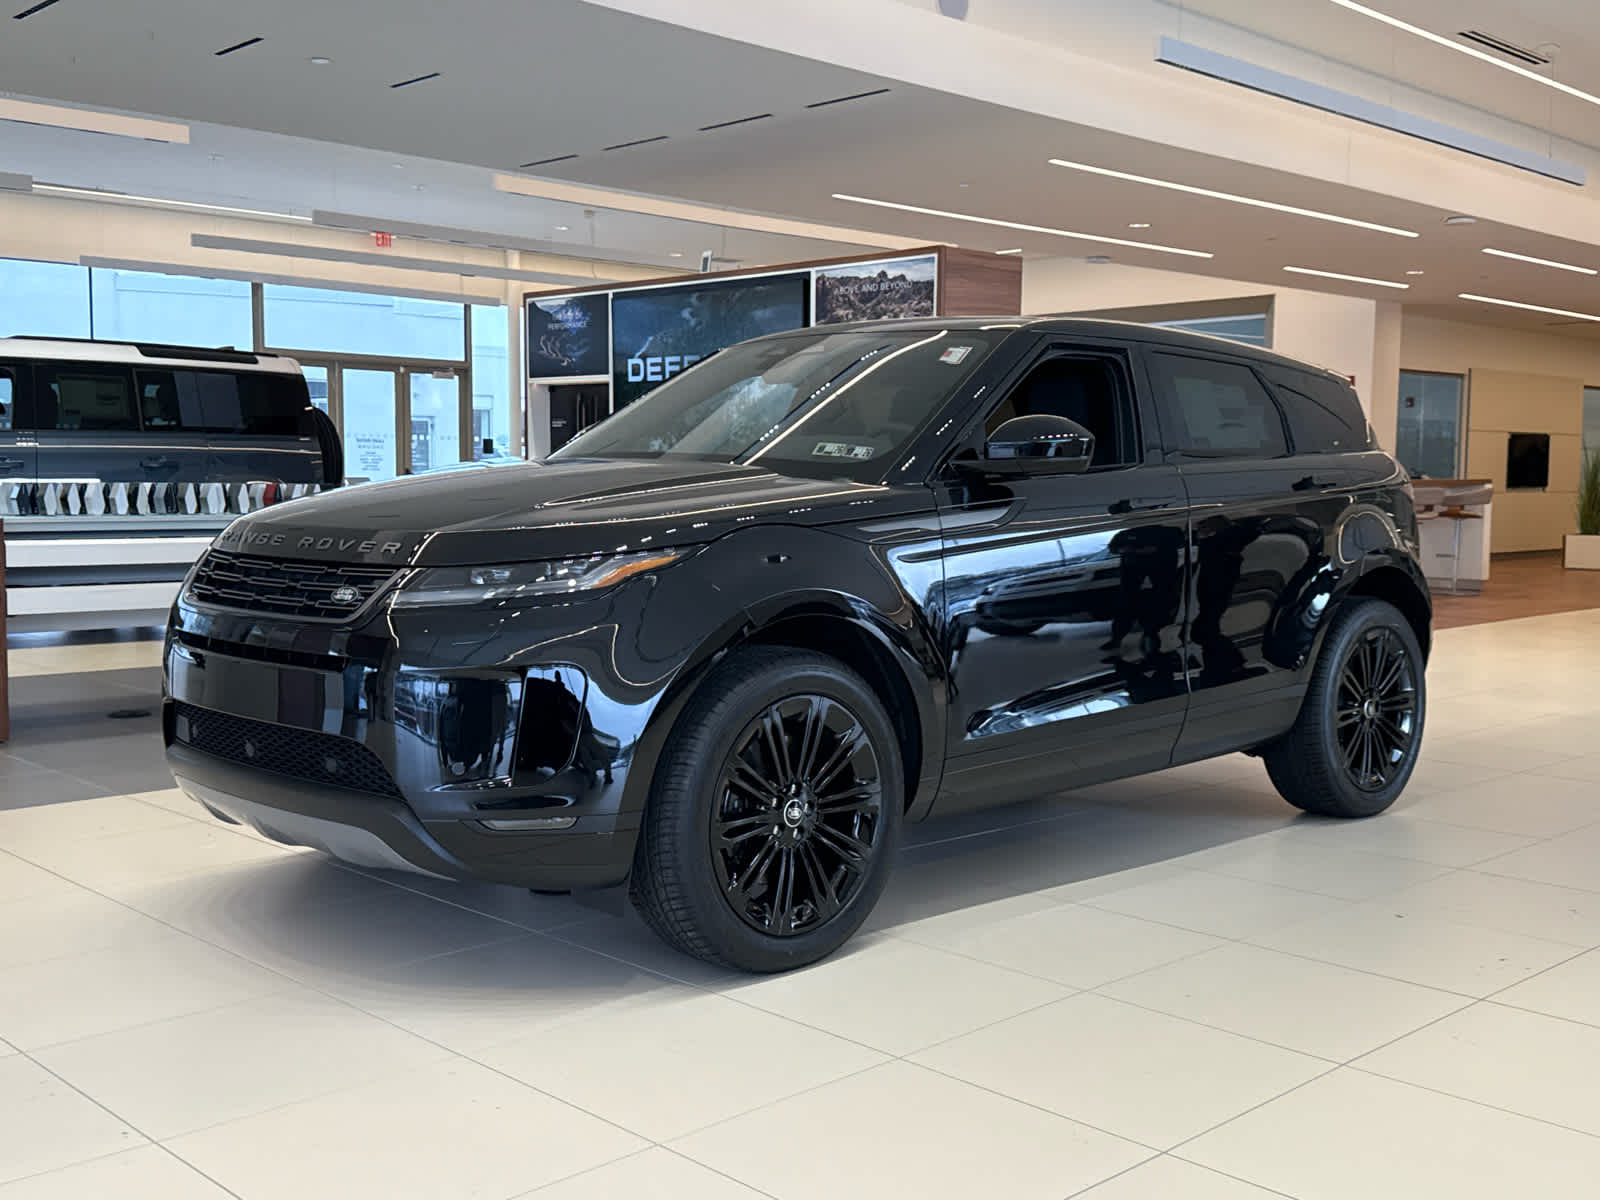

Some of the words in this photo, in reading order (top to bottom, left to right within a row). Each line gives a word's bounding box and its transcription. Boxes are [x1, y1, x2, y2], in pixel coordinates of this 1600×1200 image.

[375, 232, 392, 248] EXIT
[861, 283, 879, 292] AND
[880, 280, 913, 291] BEYOND
[223, 530, 286, 546] RANGE
[297, 536, 402, 554] ROVER
